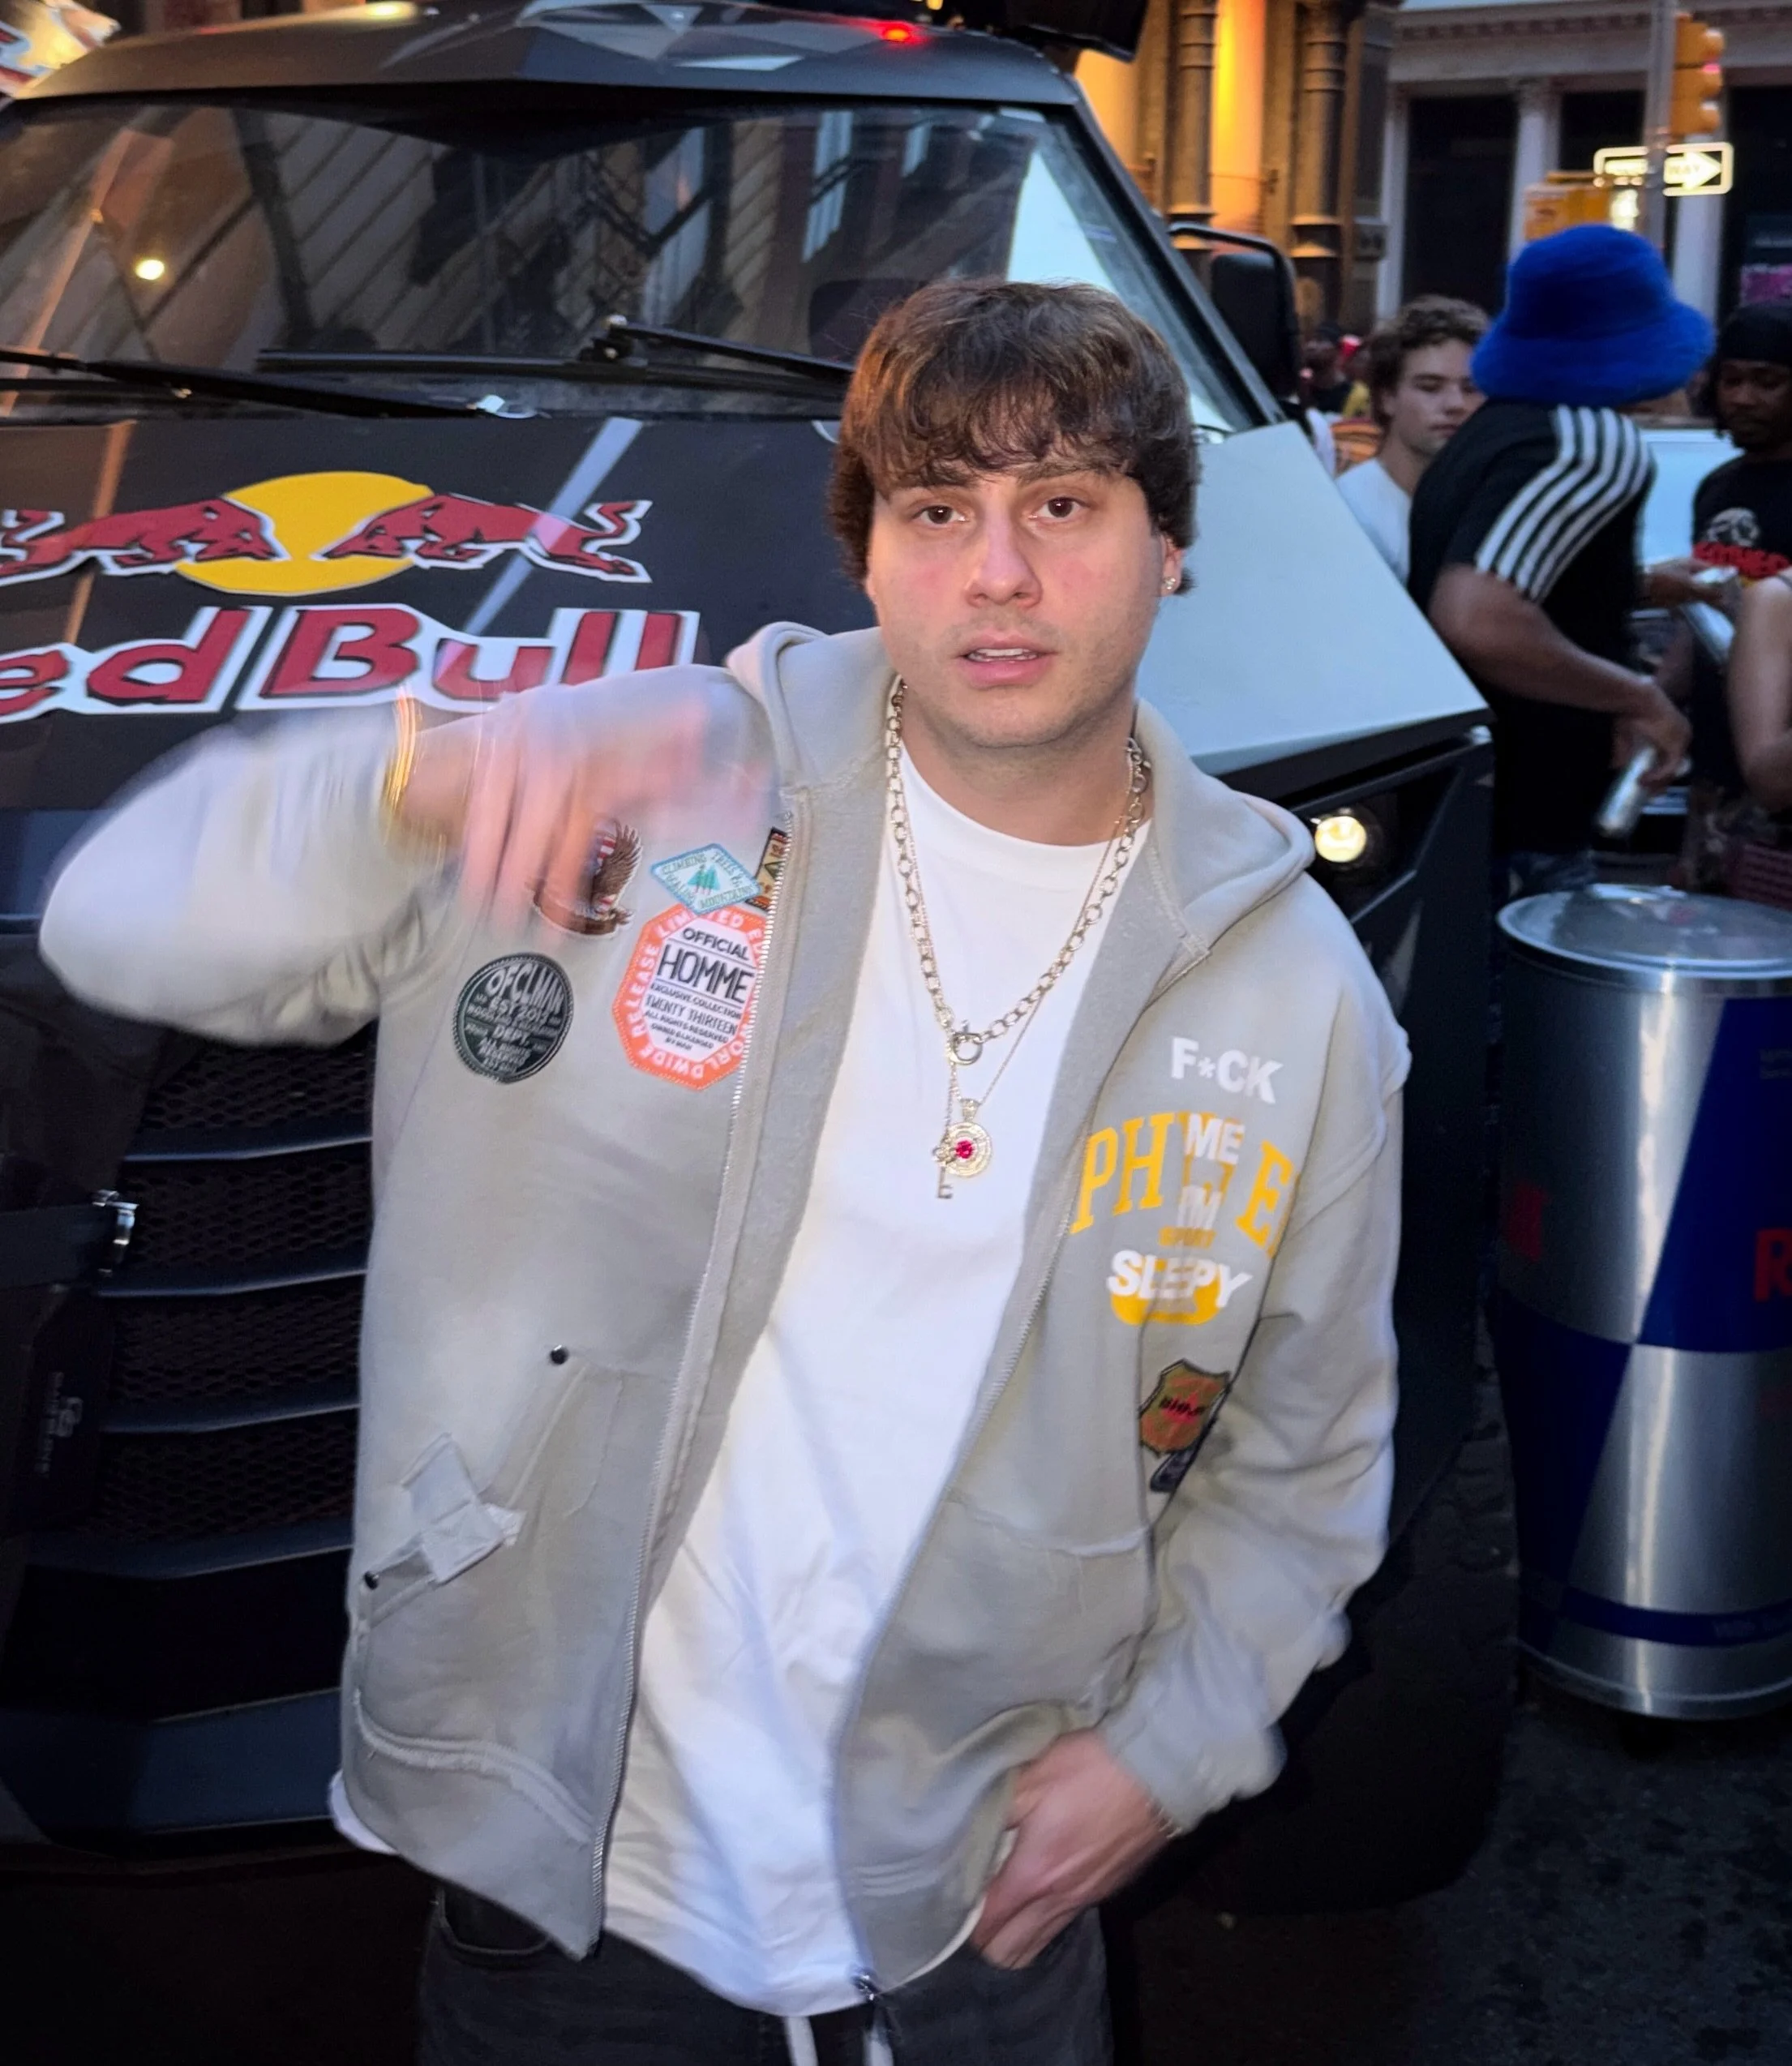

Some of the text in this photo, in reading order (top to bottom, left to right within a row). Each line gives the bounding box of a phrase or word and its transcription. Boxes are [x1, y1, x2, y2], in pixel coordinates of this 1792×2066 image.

[0, 608, 684, 714] ed Bull
[654, 909, 744, 941] LIMED
[683, 927, 749, 961] OFFICIAL
[625, 943, 659, 1038] RELEASE
[657, 944, 755, 1004] HOMME
[646, 995, 738, 1035] TWENTY THIRTEEN
[650, 984, 741, 1020] EXCLUSIVE COLLECTION
[1185, 1113, 1245, 1164] ME
